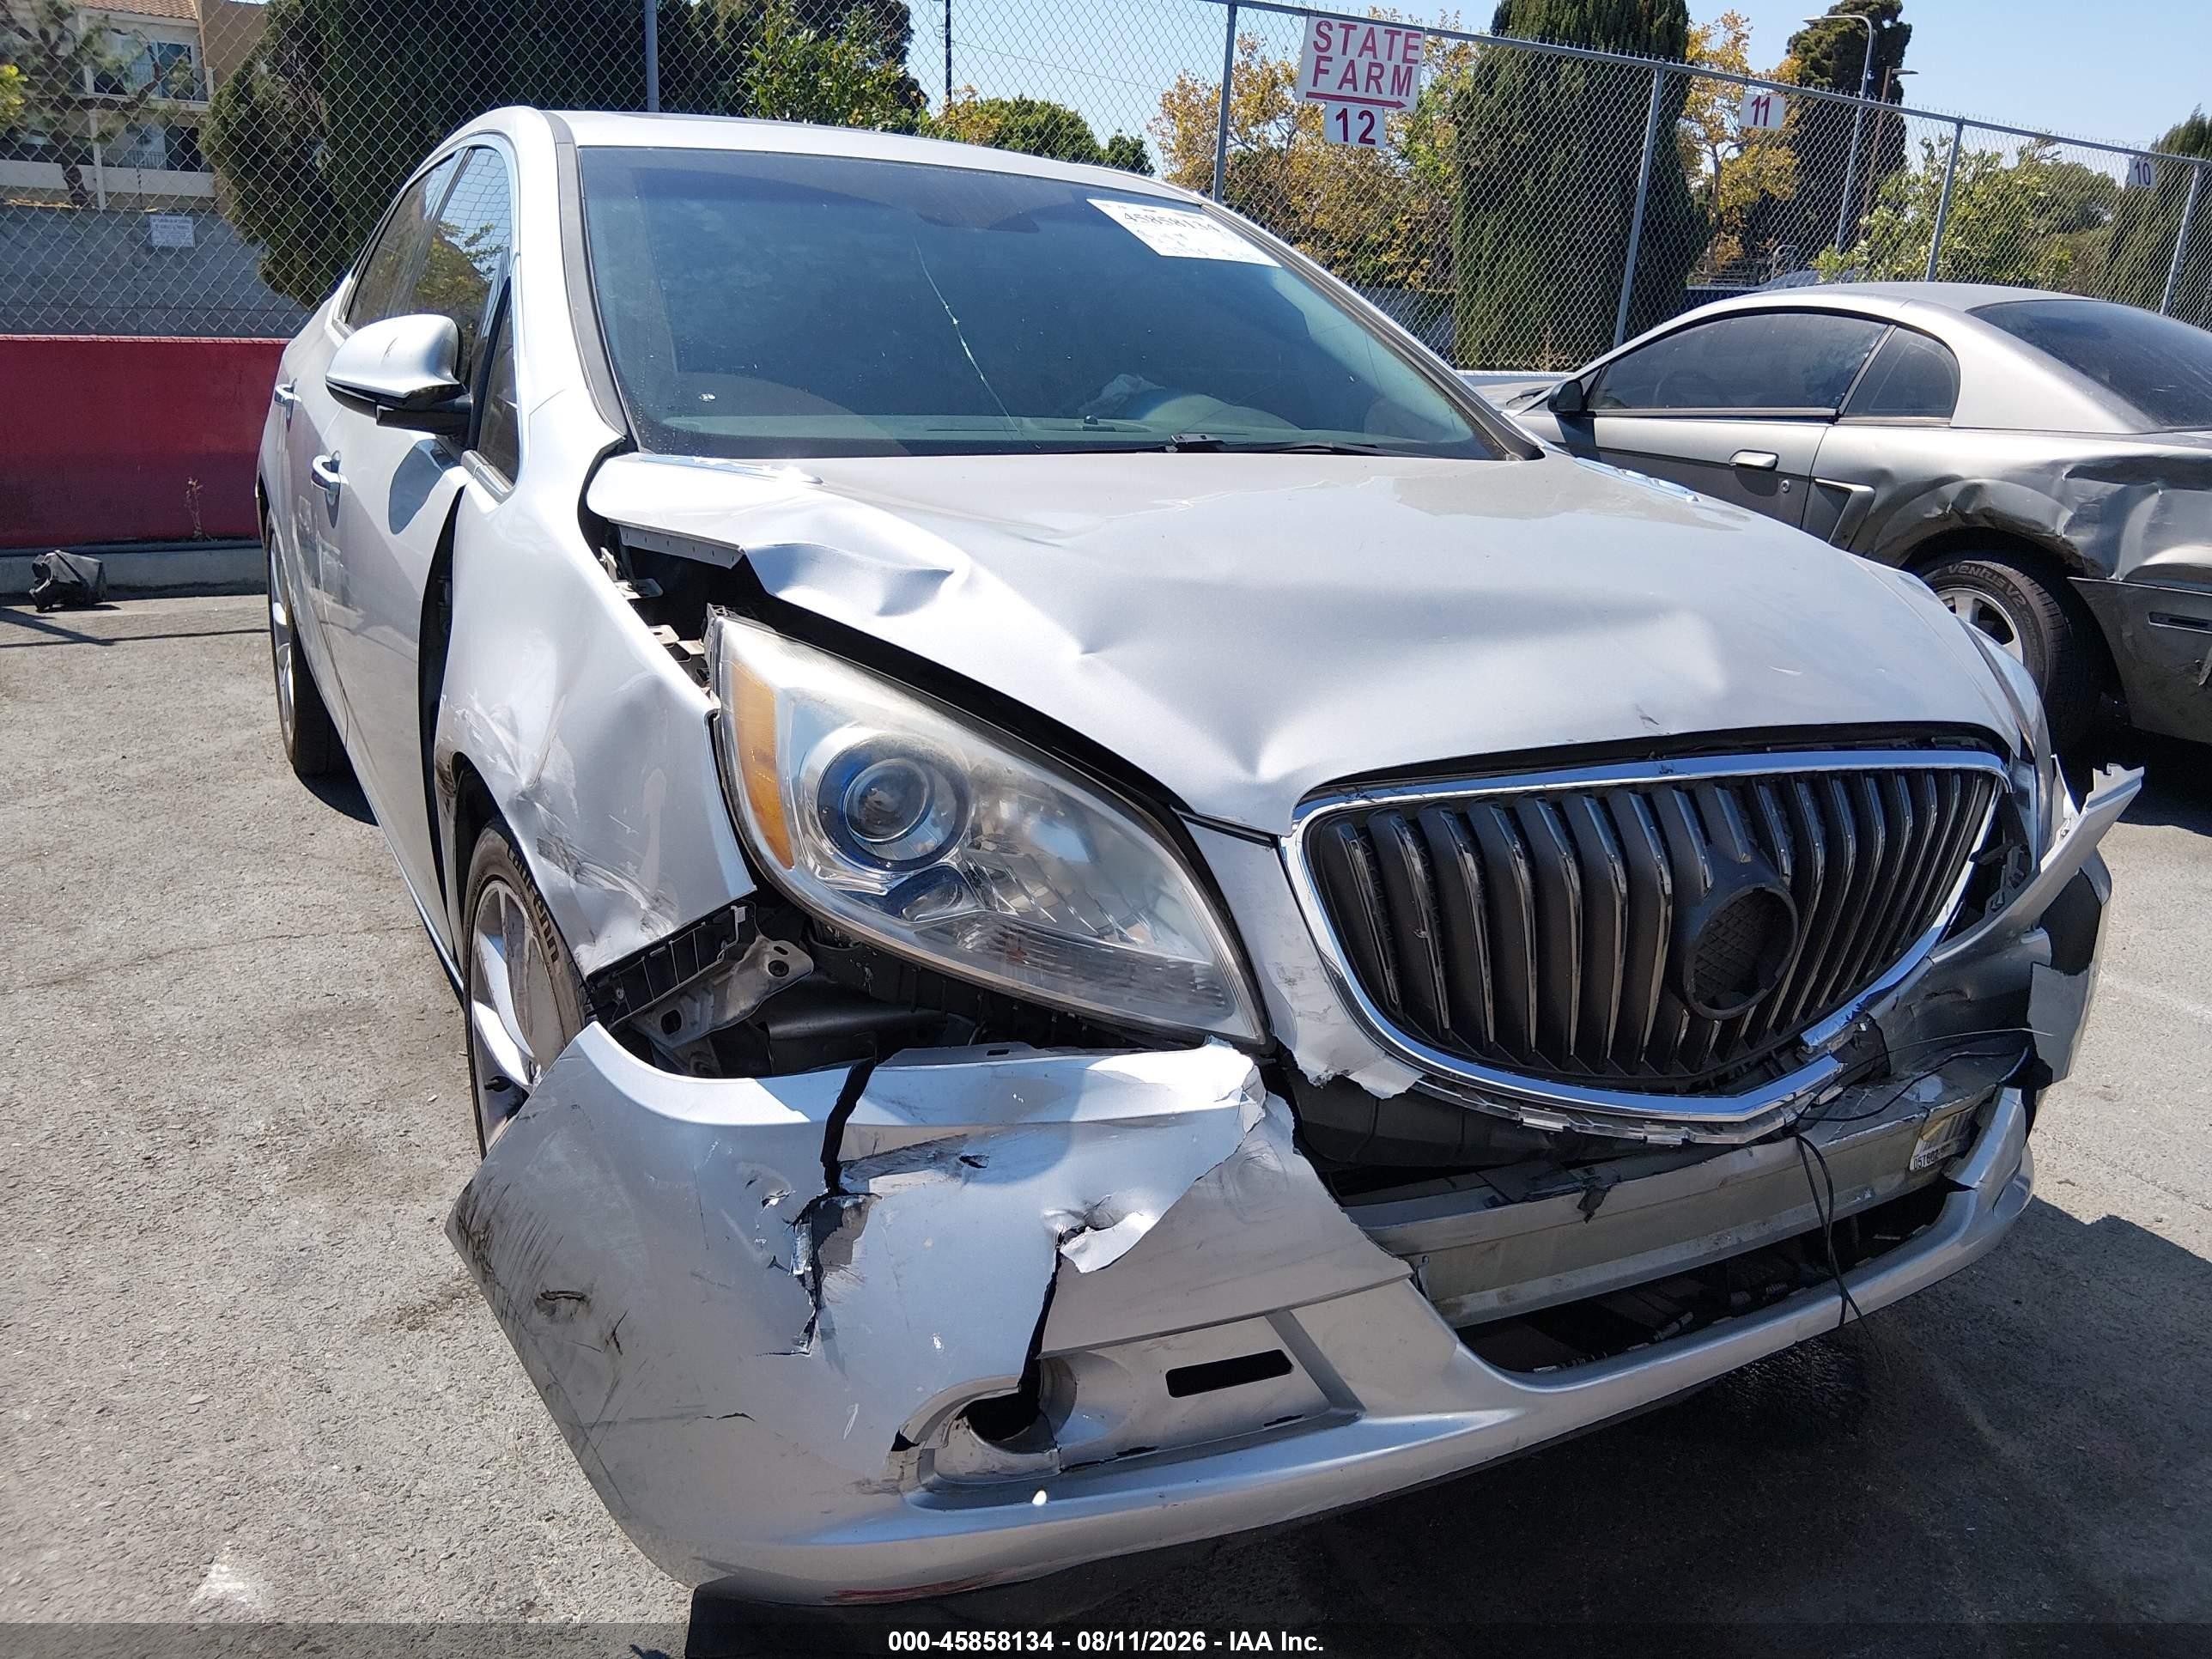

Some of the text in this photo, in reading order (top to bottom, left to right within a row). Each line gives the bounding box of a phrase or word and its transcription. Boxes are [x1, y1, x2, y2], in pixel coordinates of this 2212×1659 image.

[1312, 20, 1422, 64] STATE
[1312, 55, 1413, 97] FARM
[1335, 107, 1376, 145] 12
[1751, 95, 1771, 127] 11
[2135, 161, 2151, 186] 10
